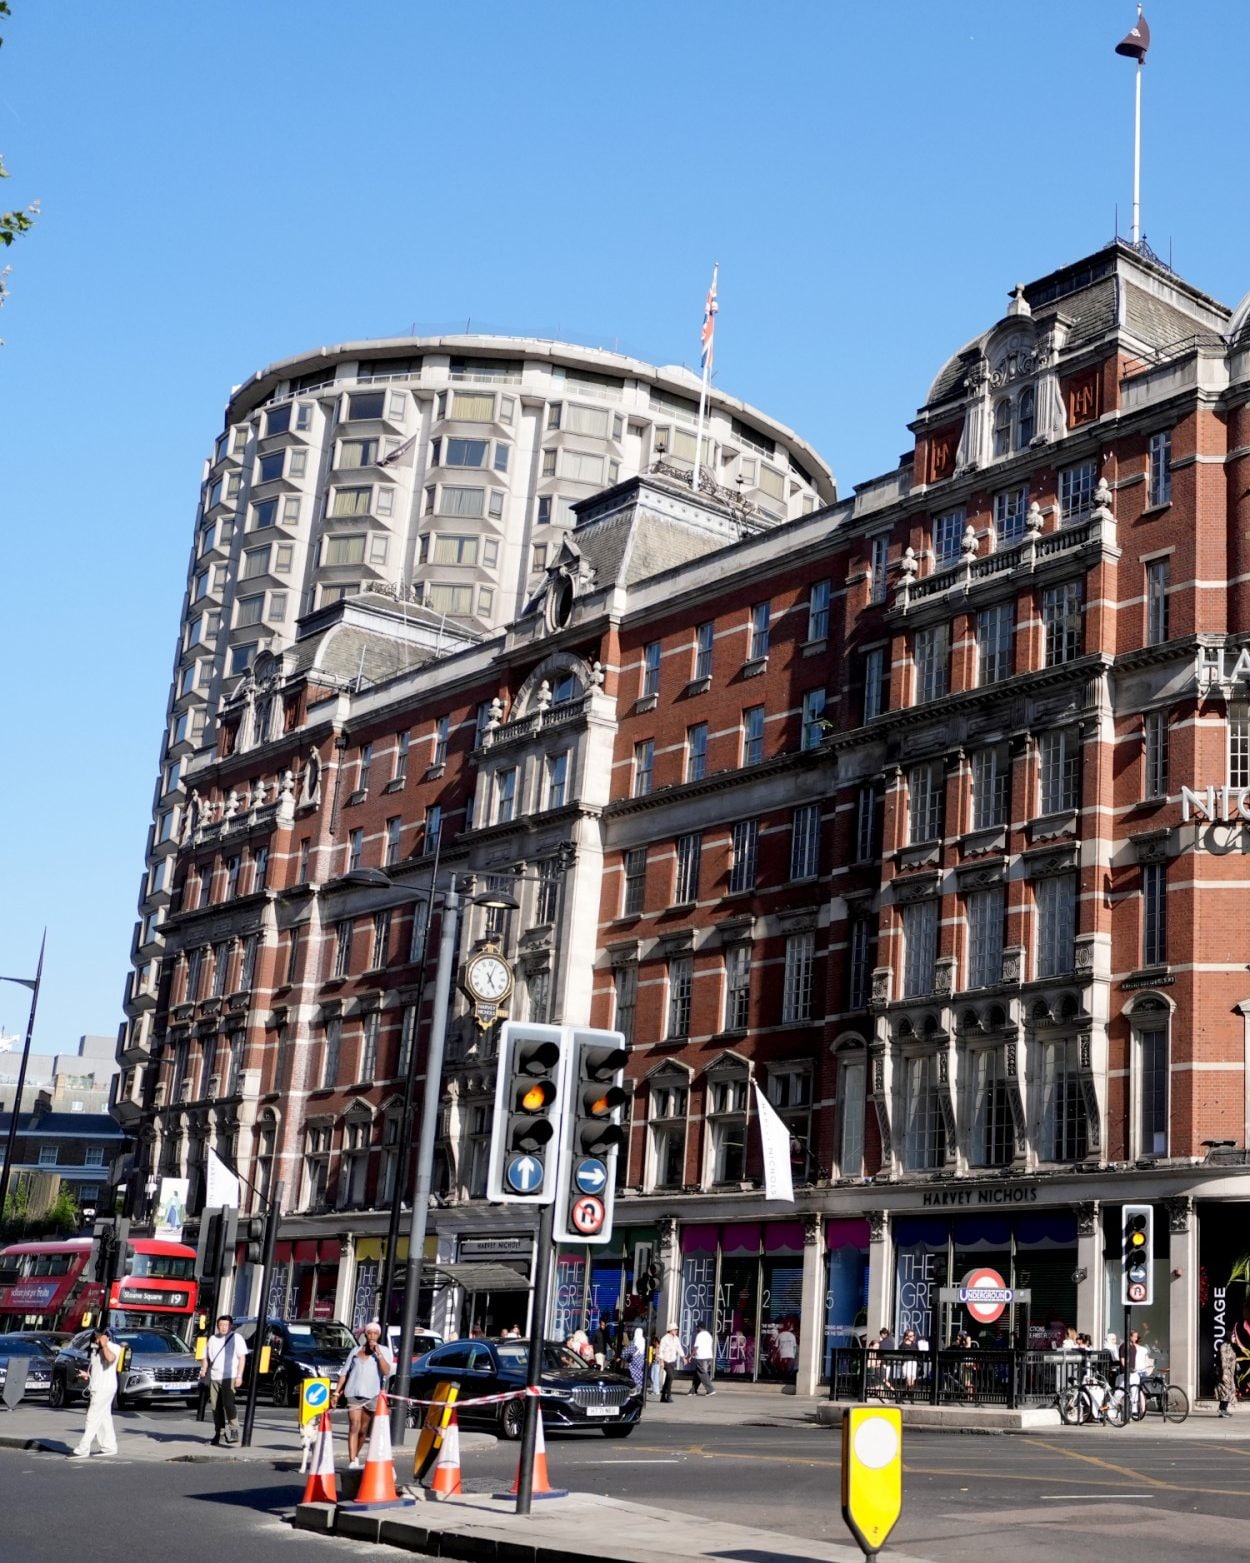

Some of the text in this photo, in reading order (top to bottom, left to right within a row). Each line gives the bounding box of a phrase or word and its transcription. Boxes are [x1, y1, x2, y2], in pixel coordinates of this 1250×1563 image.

[923, 1187, 1038, 1206] HARVEY NICHOLS
[359, 1265, 378, 1286] THE
[559, 1261, 584, 1282] THE
[687, 1258, 715, 1282] THE
[900, 1253, 936, 1281] THE
[124, 1291, 182, 1304] Sloane Square 19
[625, 1293, 632, 1308] 3
[762, 1289, 771, 1308] 2
[825, 1290, 834, 1310] 5
[959, 1288, 1013, 1302] UNDERGROUND
